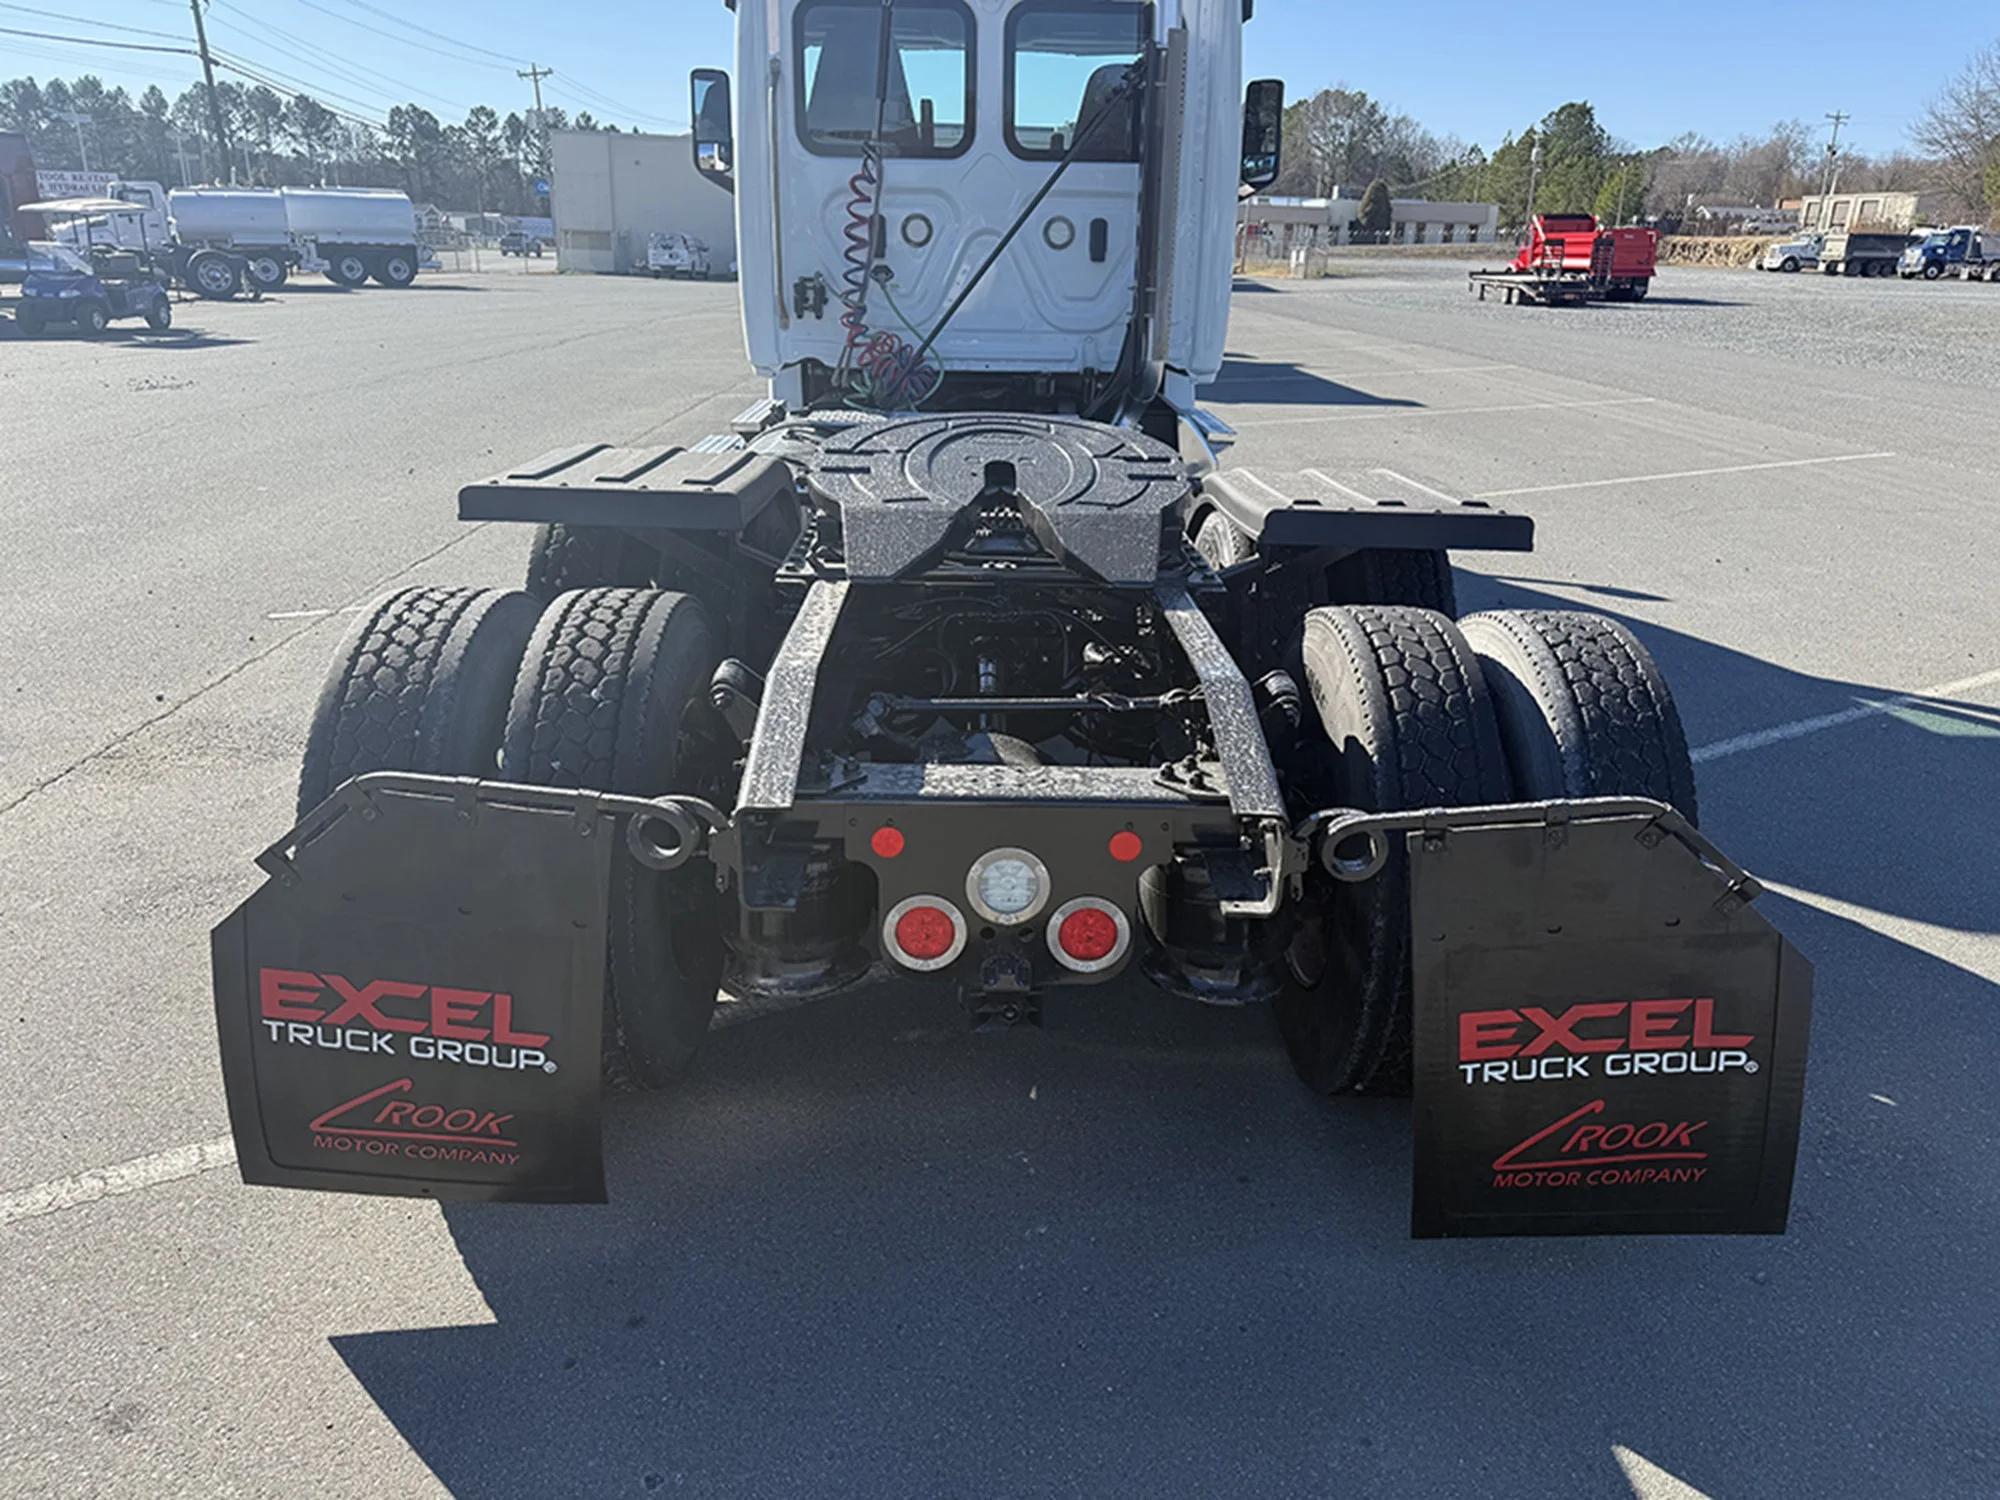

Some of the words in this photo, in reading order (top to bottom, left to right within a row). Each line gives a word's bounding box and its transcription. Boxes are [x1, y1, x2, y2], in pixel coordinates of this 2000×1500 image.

[260, 968, 551, 1048] EXCEL
[262, 1019, 396, 1055] TRUCK
[1459, 999, 1755, 1061] EXCEL
[1459, 1055, 1589, 1084] TRUCK
[313, 1134, 398, 1156] MOTOR
[404, 1143, 519, 1166] COMPANY
[1493, 1171, 1578, 1188] MOTOR
[1586, 1168, 1708, 1185] COMPANY
